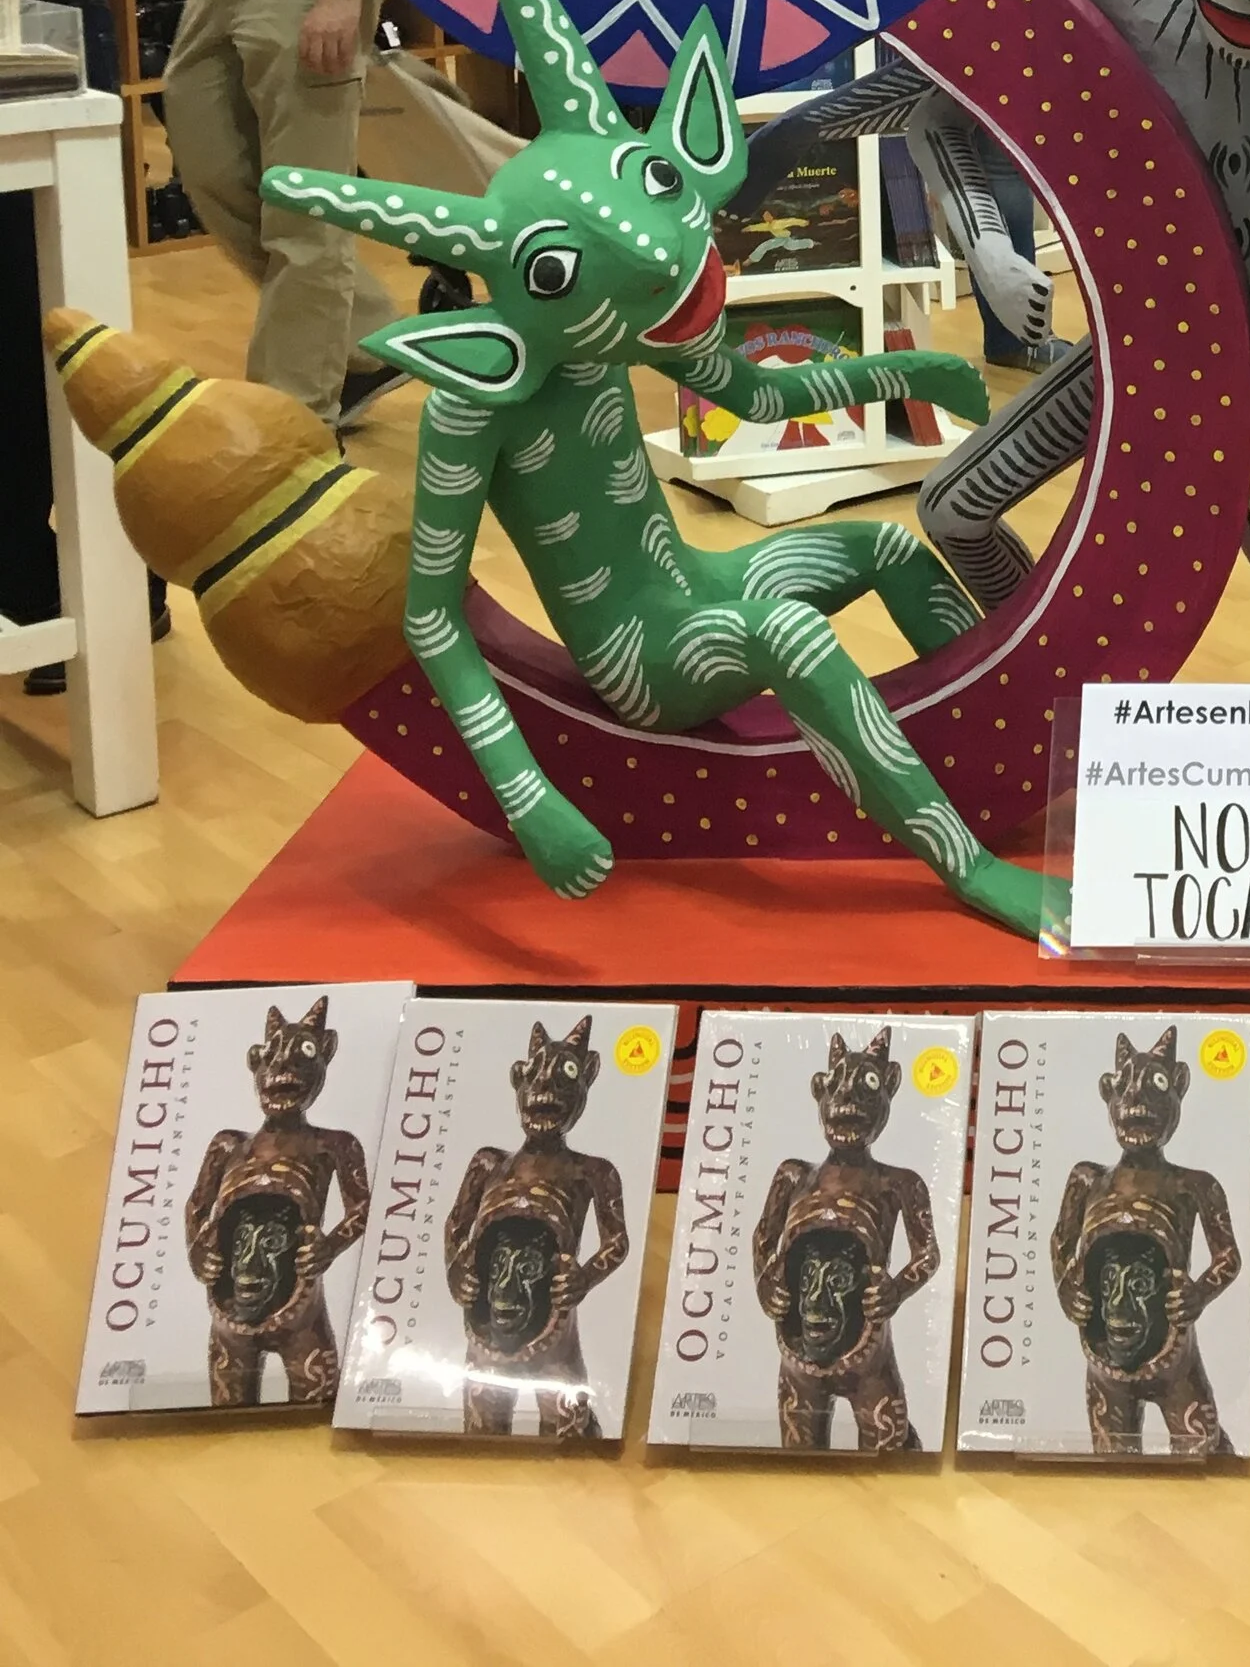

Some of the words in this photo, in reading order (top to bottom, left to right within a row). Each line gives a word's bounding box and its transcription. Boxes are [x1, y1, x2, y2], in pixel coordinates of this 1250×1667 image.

[797, 166, 837, 178] Muerte
[1174, 802, 1250, 873] NO
[105, 1017, 180, 1333] OCUMICHO
[676, 1038, 744, 1362] OCUMICHO
[981, 1039, 1028, 1368] OCUMICHO
[1022, 1229, 1037, 1366] VOCACIÓN
[1031, 1041, 1047, 1202] FANTÁSTICA
[671, 1392, 716, 1409] ARTES
[979, 1398, 1026, 1417] ARTES
